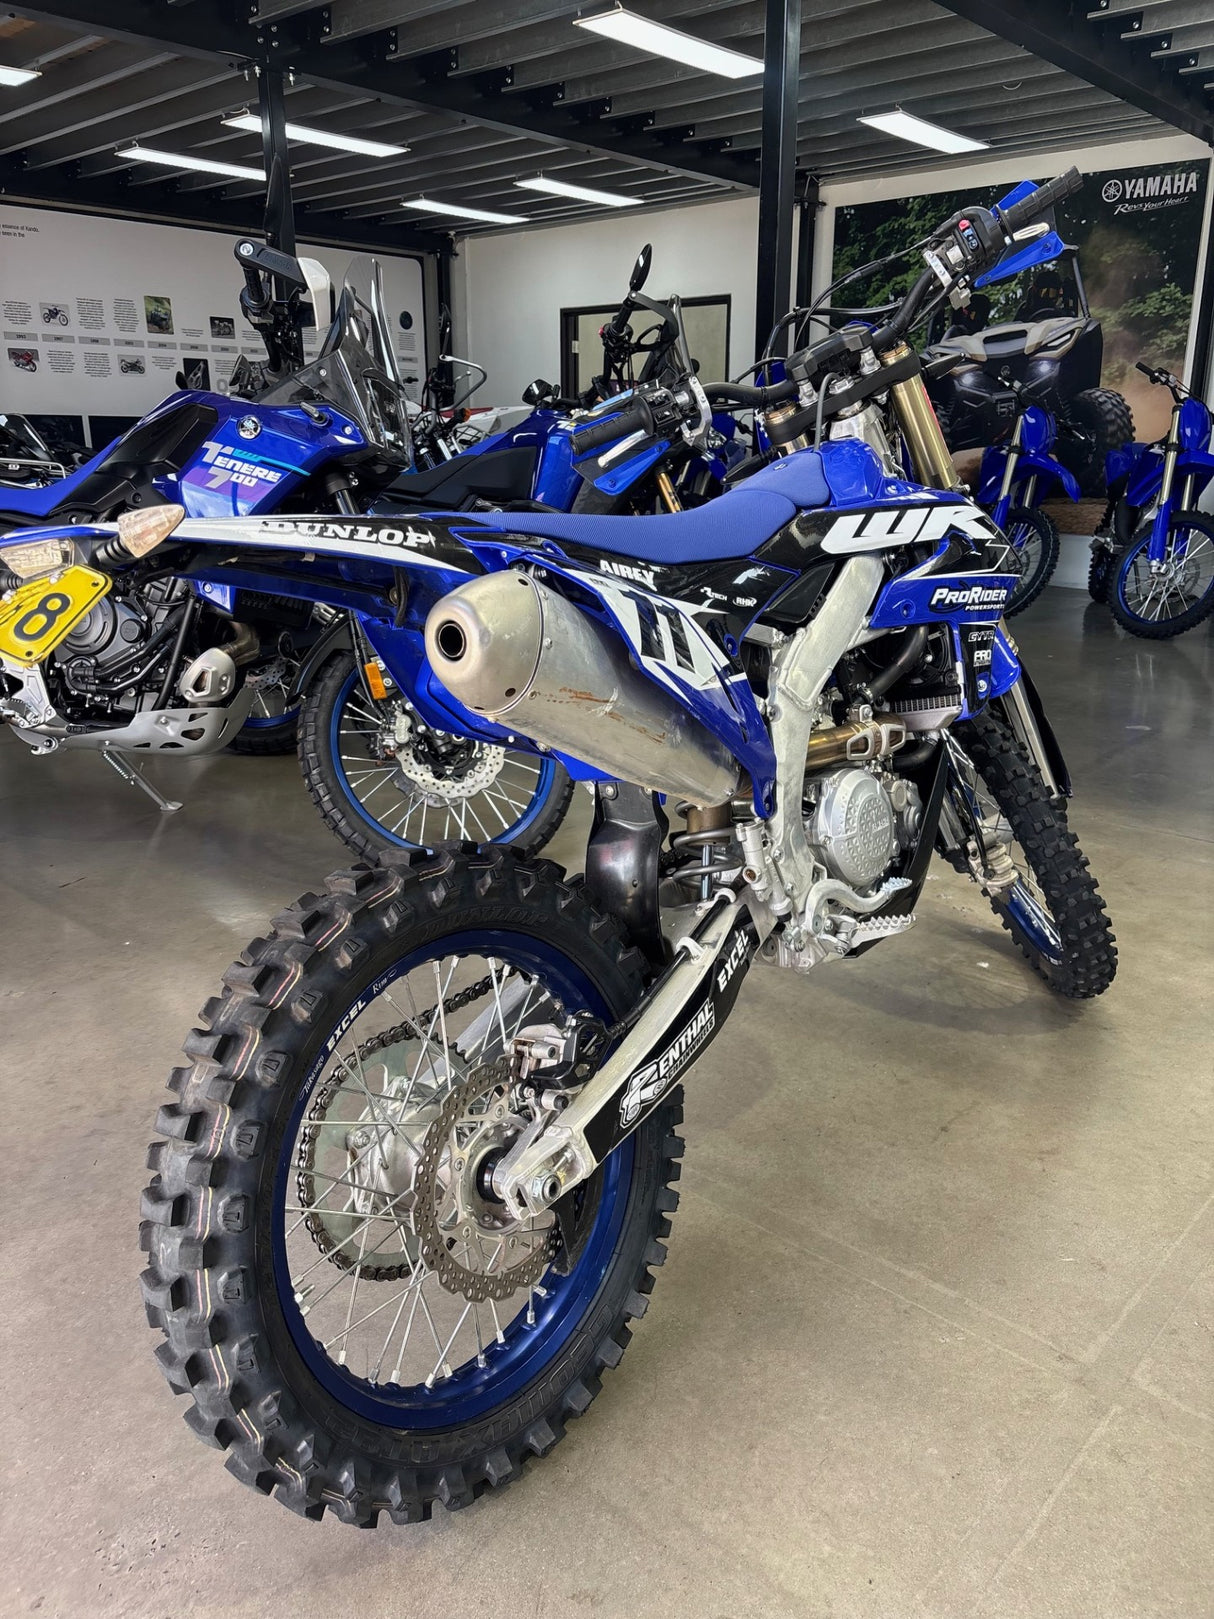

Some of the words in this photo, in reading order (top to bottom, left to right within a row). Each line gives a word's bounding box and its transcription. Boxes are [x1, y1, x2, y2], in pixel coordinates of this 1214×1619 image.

[1124, 171, 1198, 200] YAMAHA
[1113, 202, 1144, 216] Revs
[1143, 200, 1165, 212] Your
[1164, 195, 1190, 208] Heart
[204, 465, 259, 489] 700
[260, 520, 431, 548] DUNLOP
[820, 504, 997, 555] WR
[599, 559, 658, 592] AIREY
[13, 592, 72, 642] 8
[968, 629, 995, 643] GYTR
[716, 928, 749, 994] EXCEL
[325, 999, 367, 1052] EXCEL
